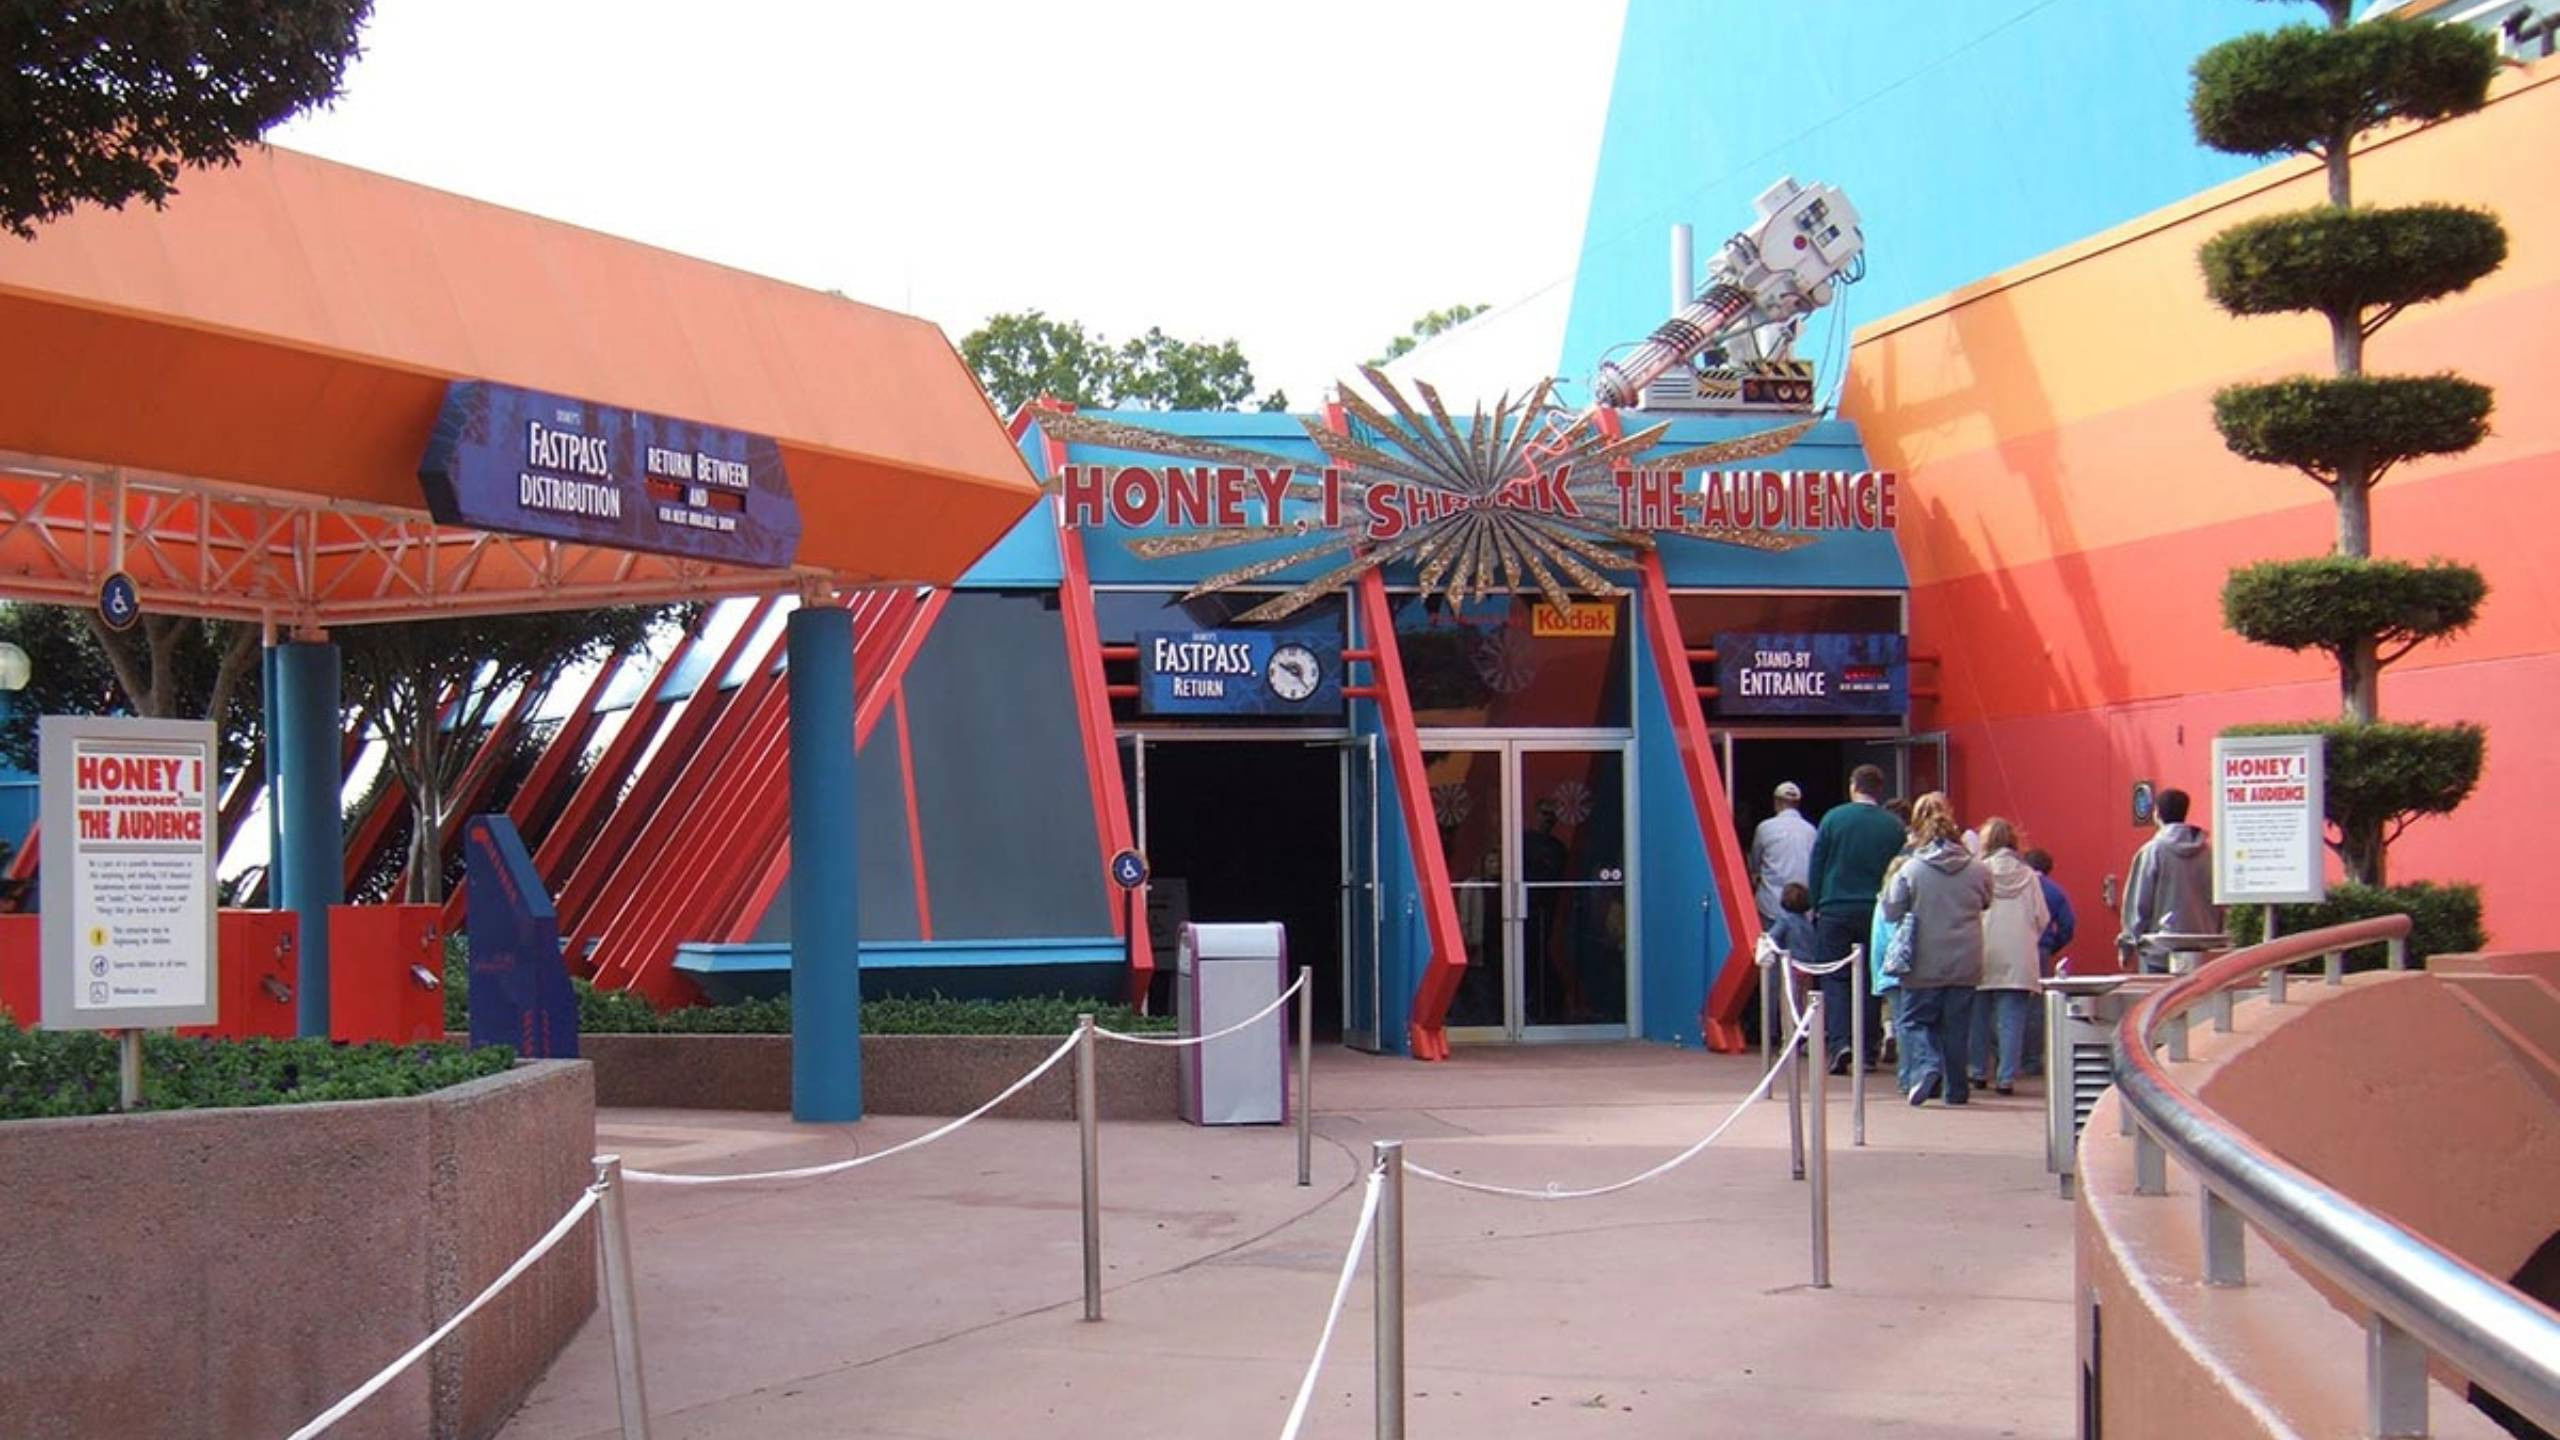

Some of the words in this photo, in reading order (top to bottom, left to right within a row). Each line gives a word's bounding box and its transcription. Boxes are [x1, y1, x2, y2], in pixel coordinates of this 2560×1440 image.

[530, 421, 607, 476] FASTPASS
[647, 446, 693, 479] RETURN
[696, 451, 750, 489] BETWEEN
[520, 473, 620, 518] DISTRIBUTION
[1060, 464, 1308, 537] HONEY,
[1322, 465, 1342, 528] I
[1612, 467, 1686, 530] THE
[1699, 468, 1897, 531] AUDIENCE
[1537, 610, 1611, 631] Kodak
[1155, 638, 1251, 674] FASTPASS
[1755, 651, 1811, 669] STAND-BY
[1173, 677, 1224, 697] RETURN
[1740, 668, 1826, 696] ENTRANCE
[193, 760, 203, 792] I
[2299, 758, 2305, 775] I
[2250, 785, 2305, 802] AUDIENCE
[79, 810, 111, 839] THE
[117, 811, 203, 840] AUDIENCE
